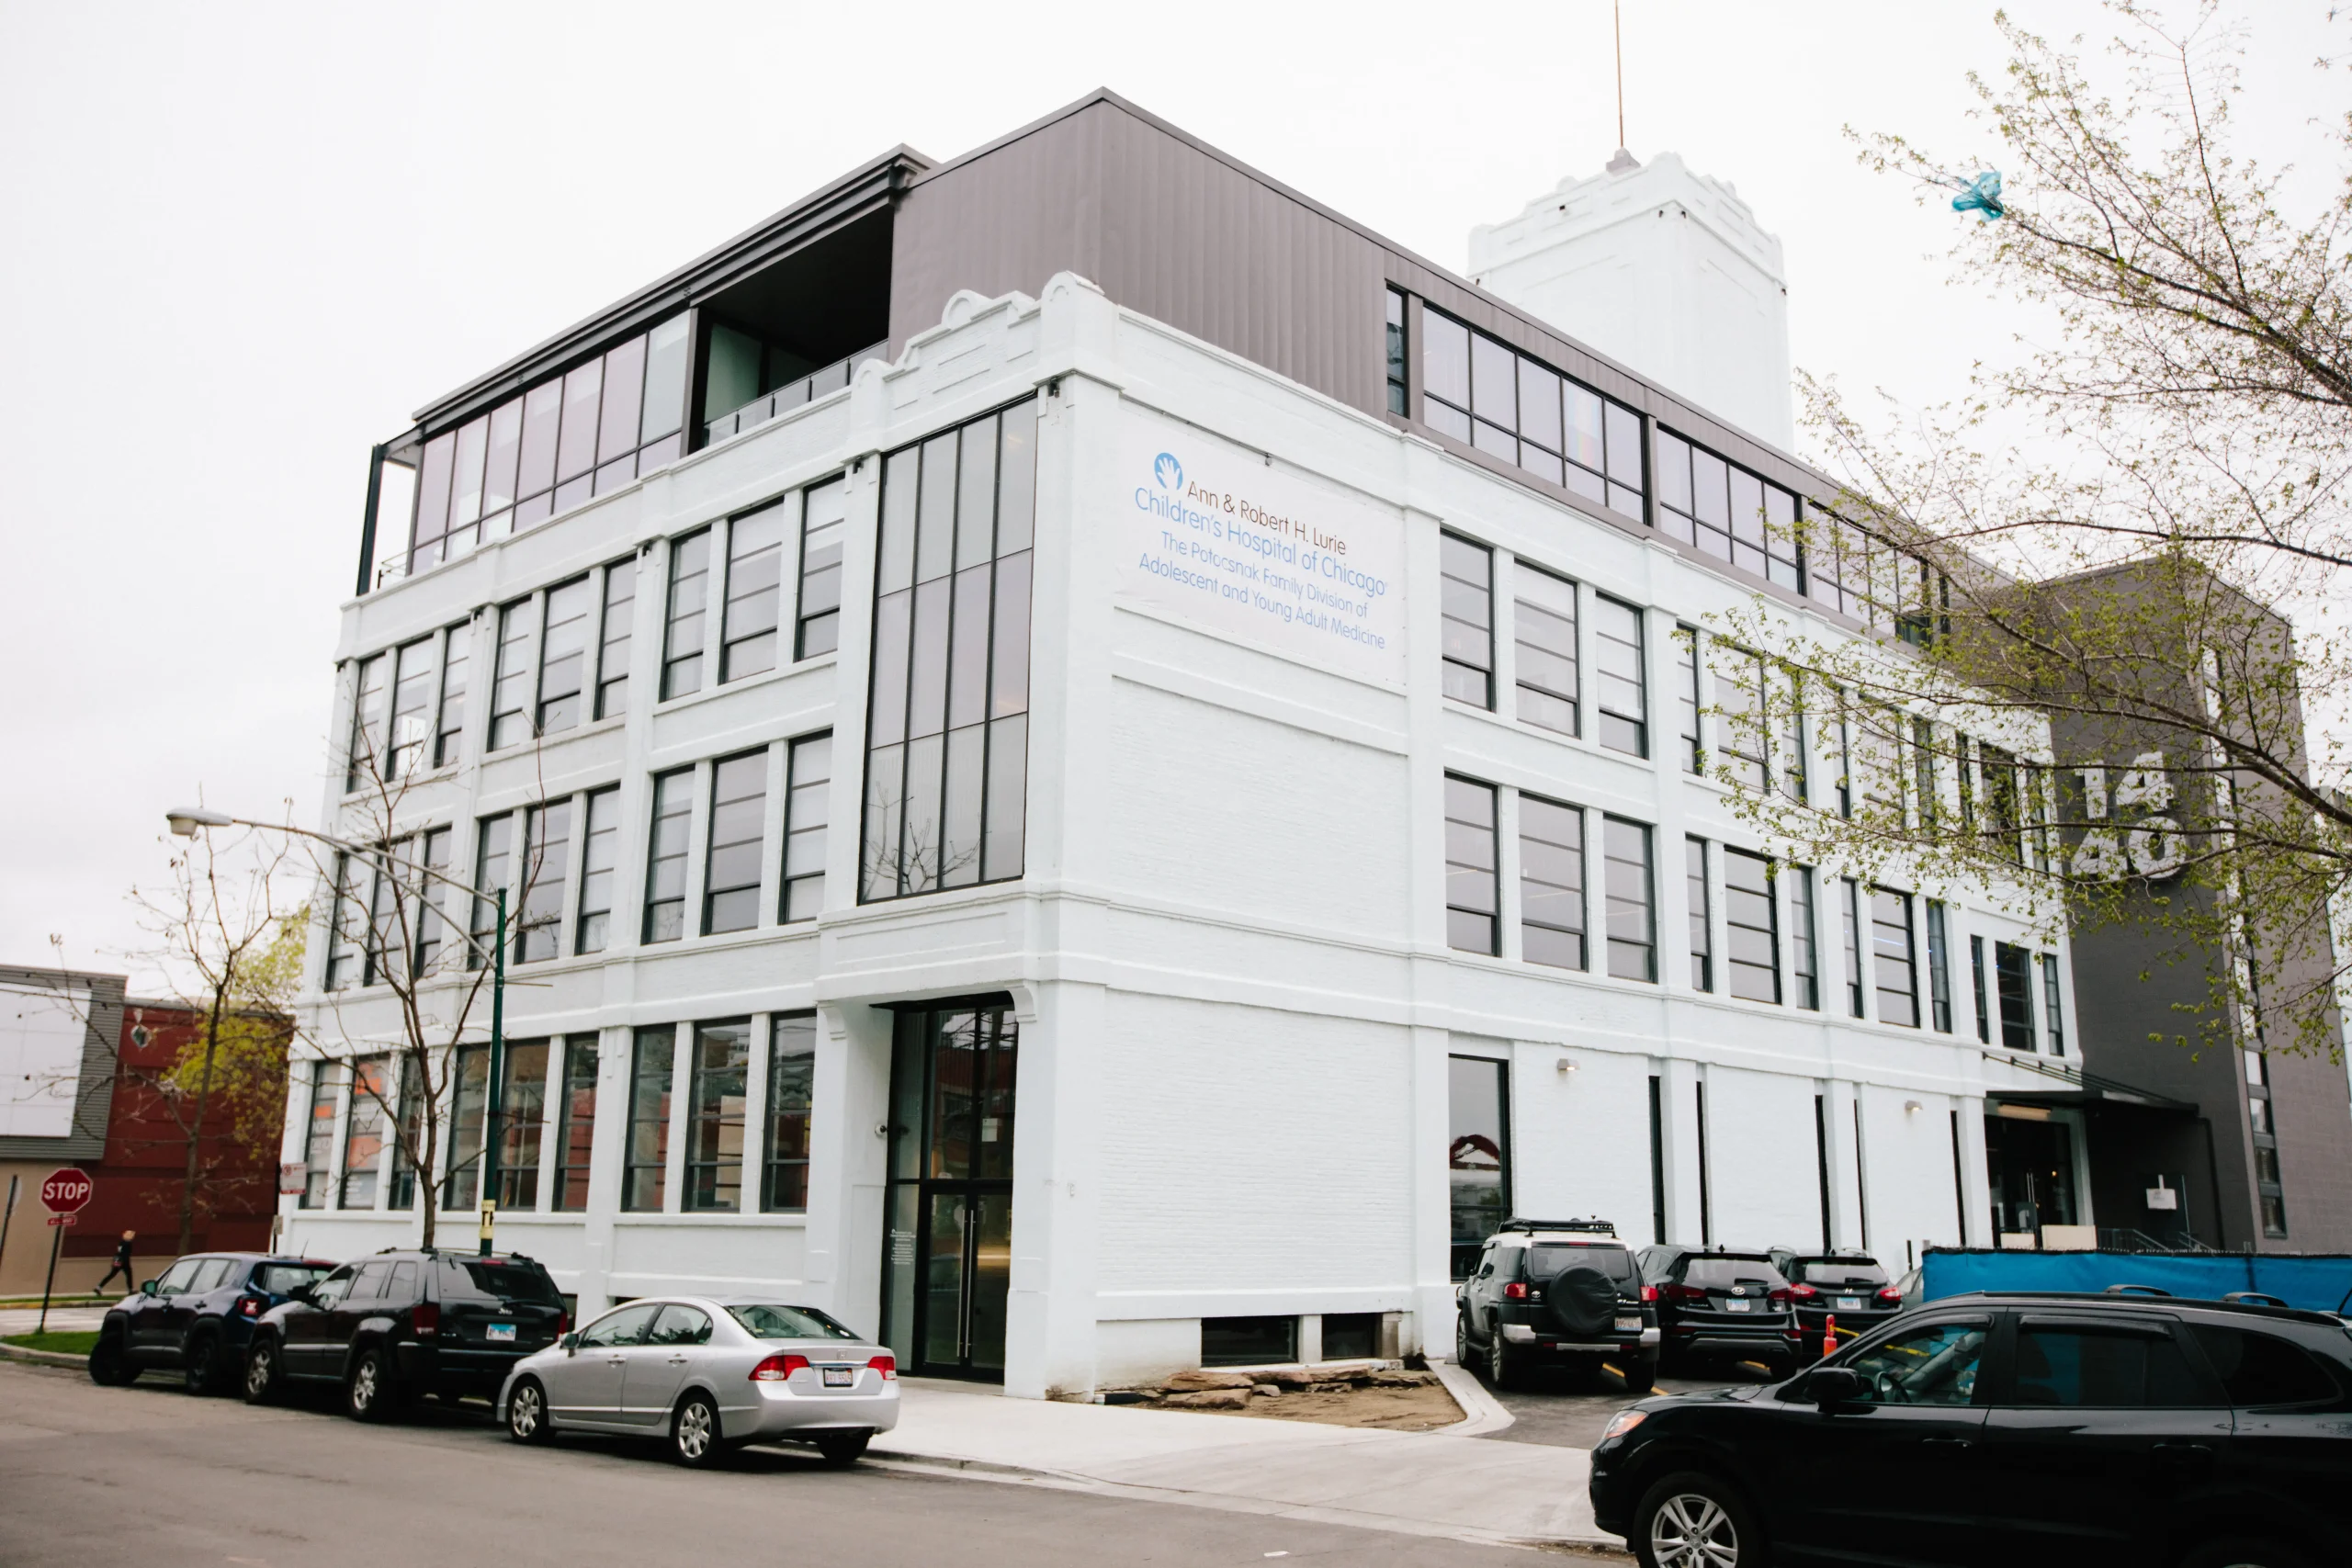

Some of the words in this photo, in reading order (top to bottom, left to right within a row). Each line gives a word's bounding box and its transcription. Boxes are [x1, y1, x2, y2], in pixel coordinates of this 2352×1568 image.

[1135, 487, 1222, 537] Children's
[1227, 520, 1296, 566] Hospital
[1302, 550, 1317, 572] of
[1187, 480, 1218, 509] Ann
[1223, 493, 1236, 515] &
[1240, 499, 1289, 535] Robert
[1295, 520, 1309, 543] H.
[1313, 527, 1346, 556] Lurie
[1139, 552, 1218, 592] Adolescent
[1222, 584, 1249, 604] and
[1251, 592, 1292, 623] Young
[1295, 605, 1329, 632] Adult
[1330, 616, 1385, 649] Medicine
[1161, 530, 1187, 556] The
[1192, 541, 1261, 582] Potocsnak
[1263, 568, 1304, 601] Family
[1307, 583, 1353, 615] Division
[1356, 603, 1368, 618] of
[2074, 750, 2175, 820] 14
[2070, 816, 2187, 881] 40
[43, 1181, 89, 1201] STOP
